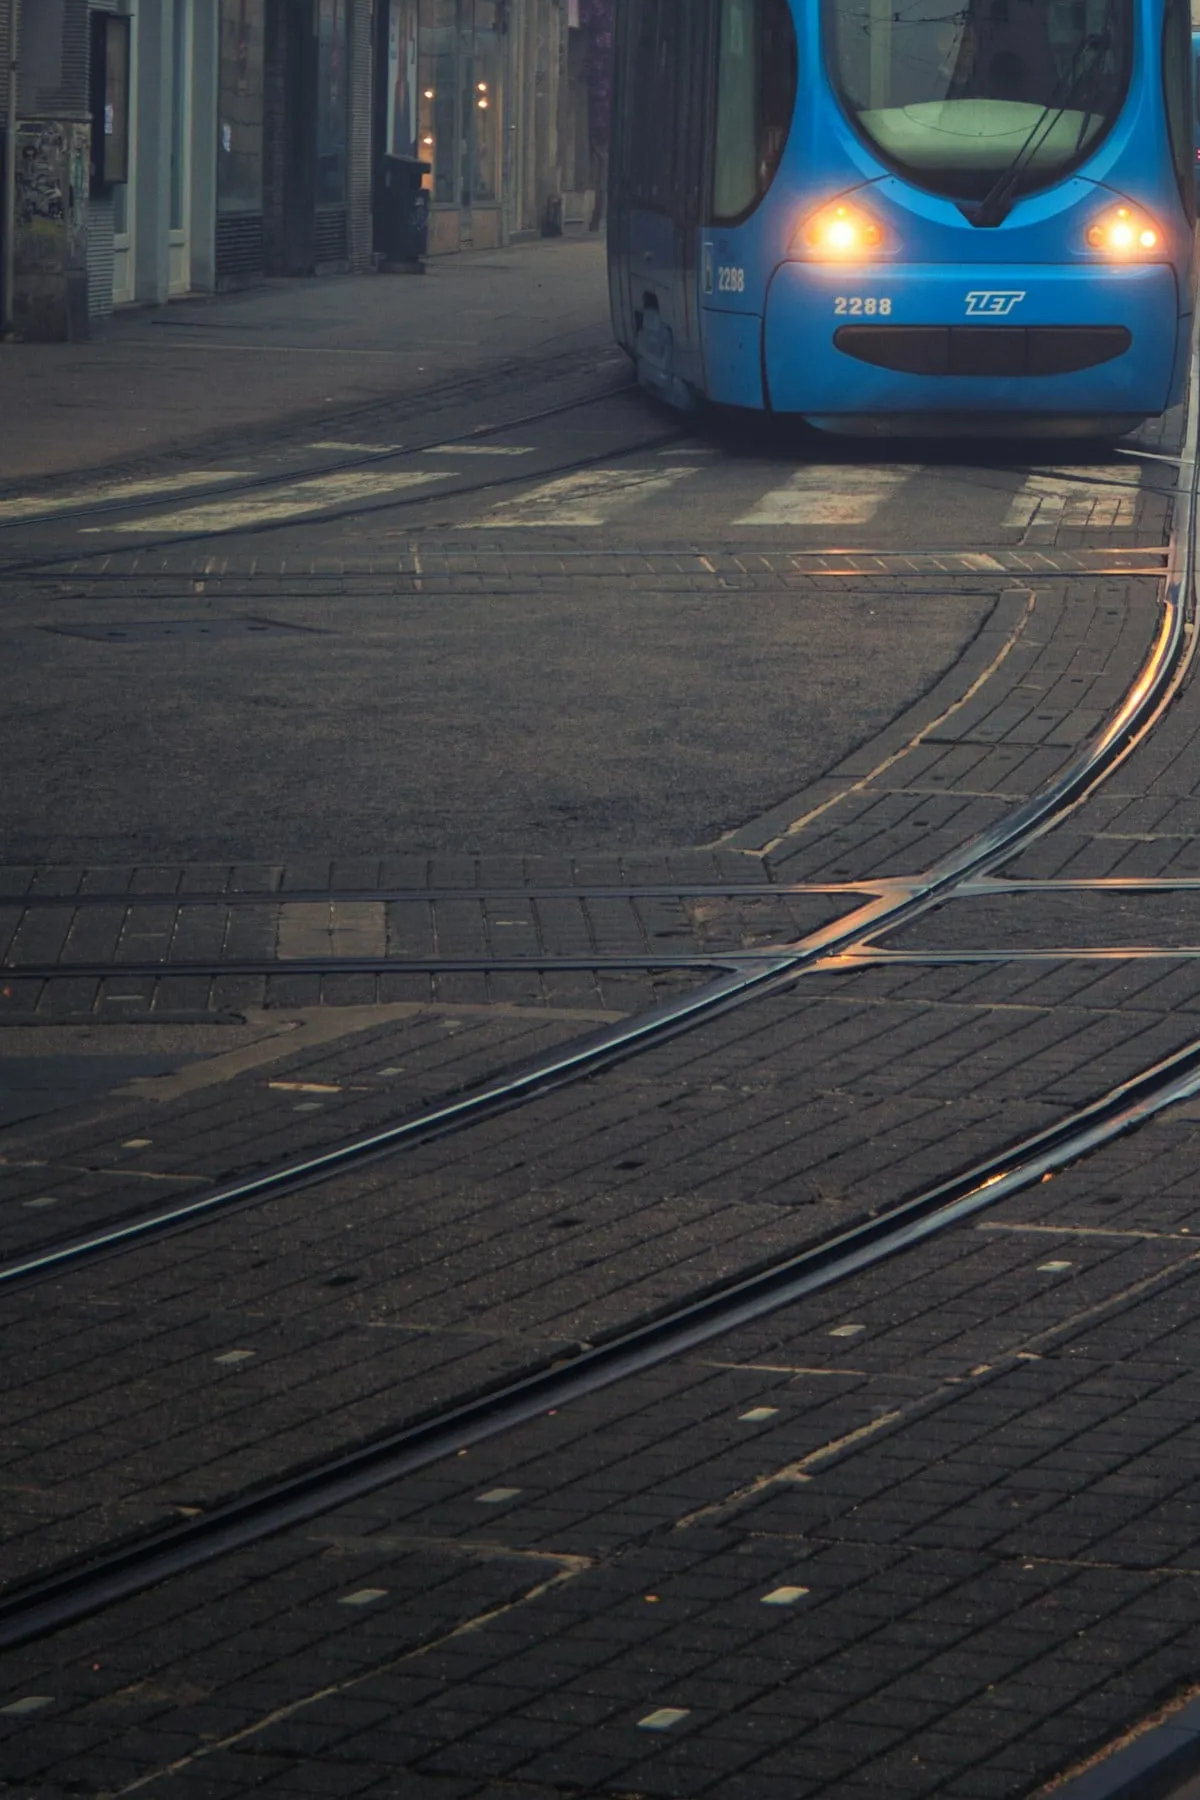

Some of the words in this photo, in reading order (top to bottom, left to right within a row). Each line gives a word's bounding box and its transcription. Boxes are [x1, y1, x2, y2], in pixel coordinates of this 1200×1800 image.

[718, 266, 746, 293] 2288
[834, 297, 892, 316] 2288
[964, 290, 1027, 316] ZET
